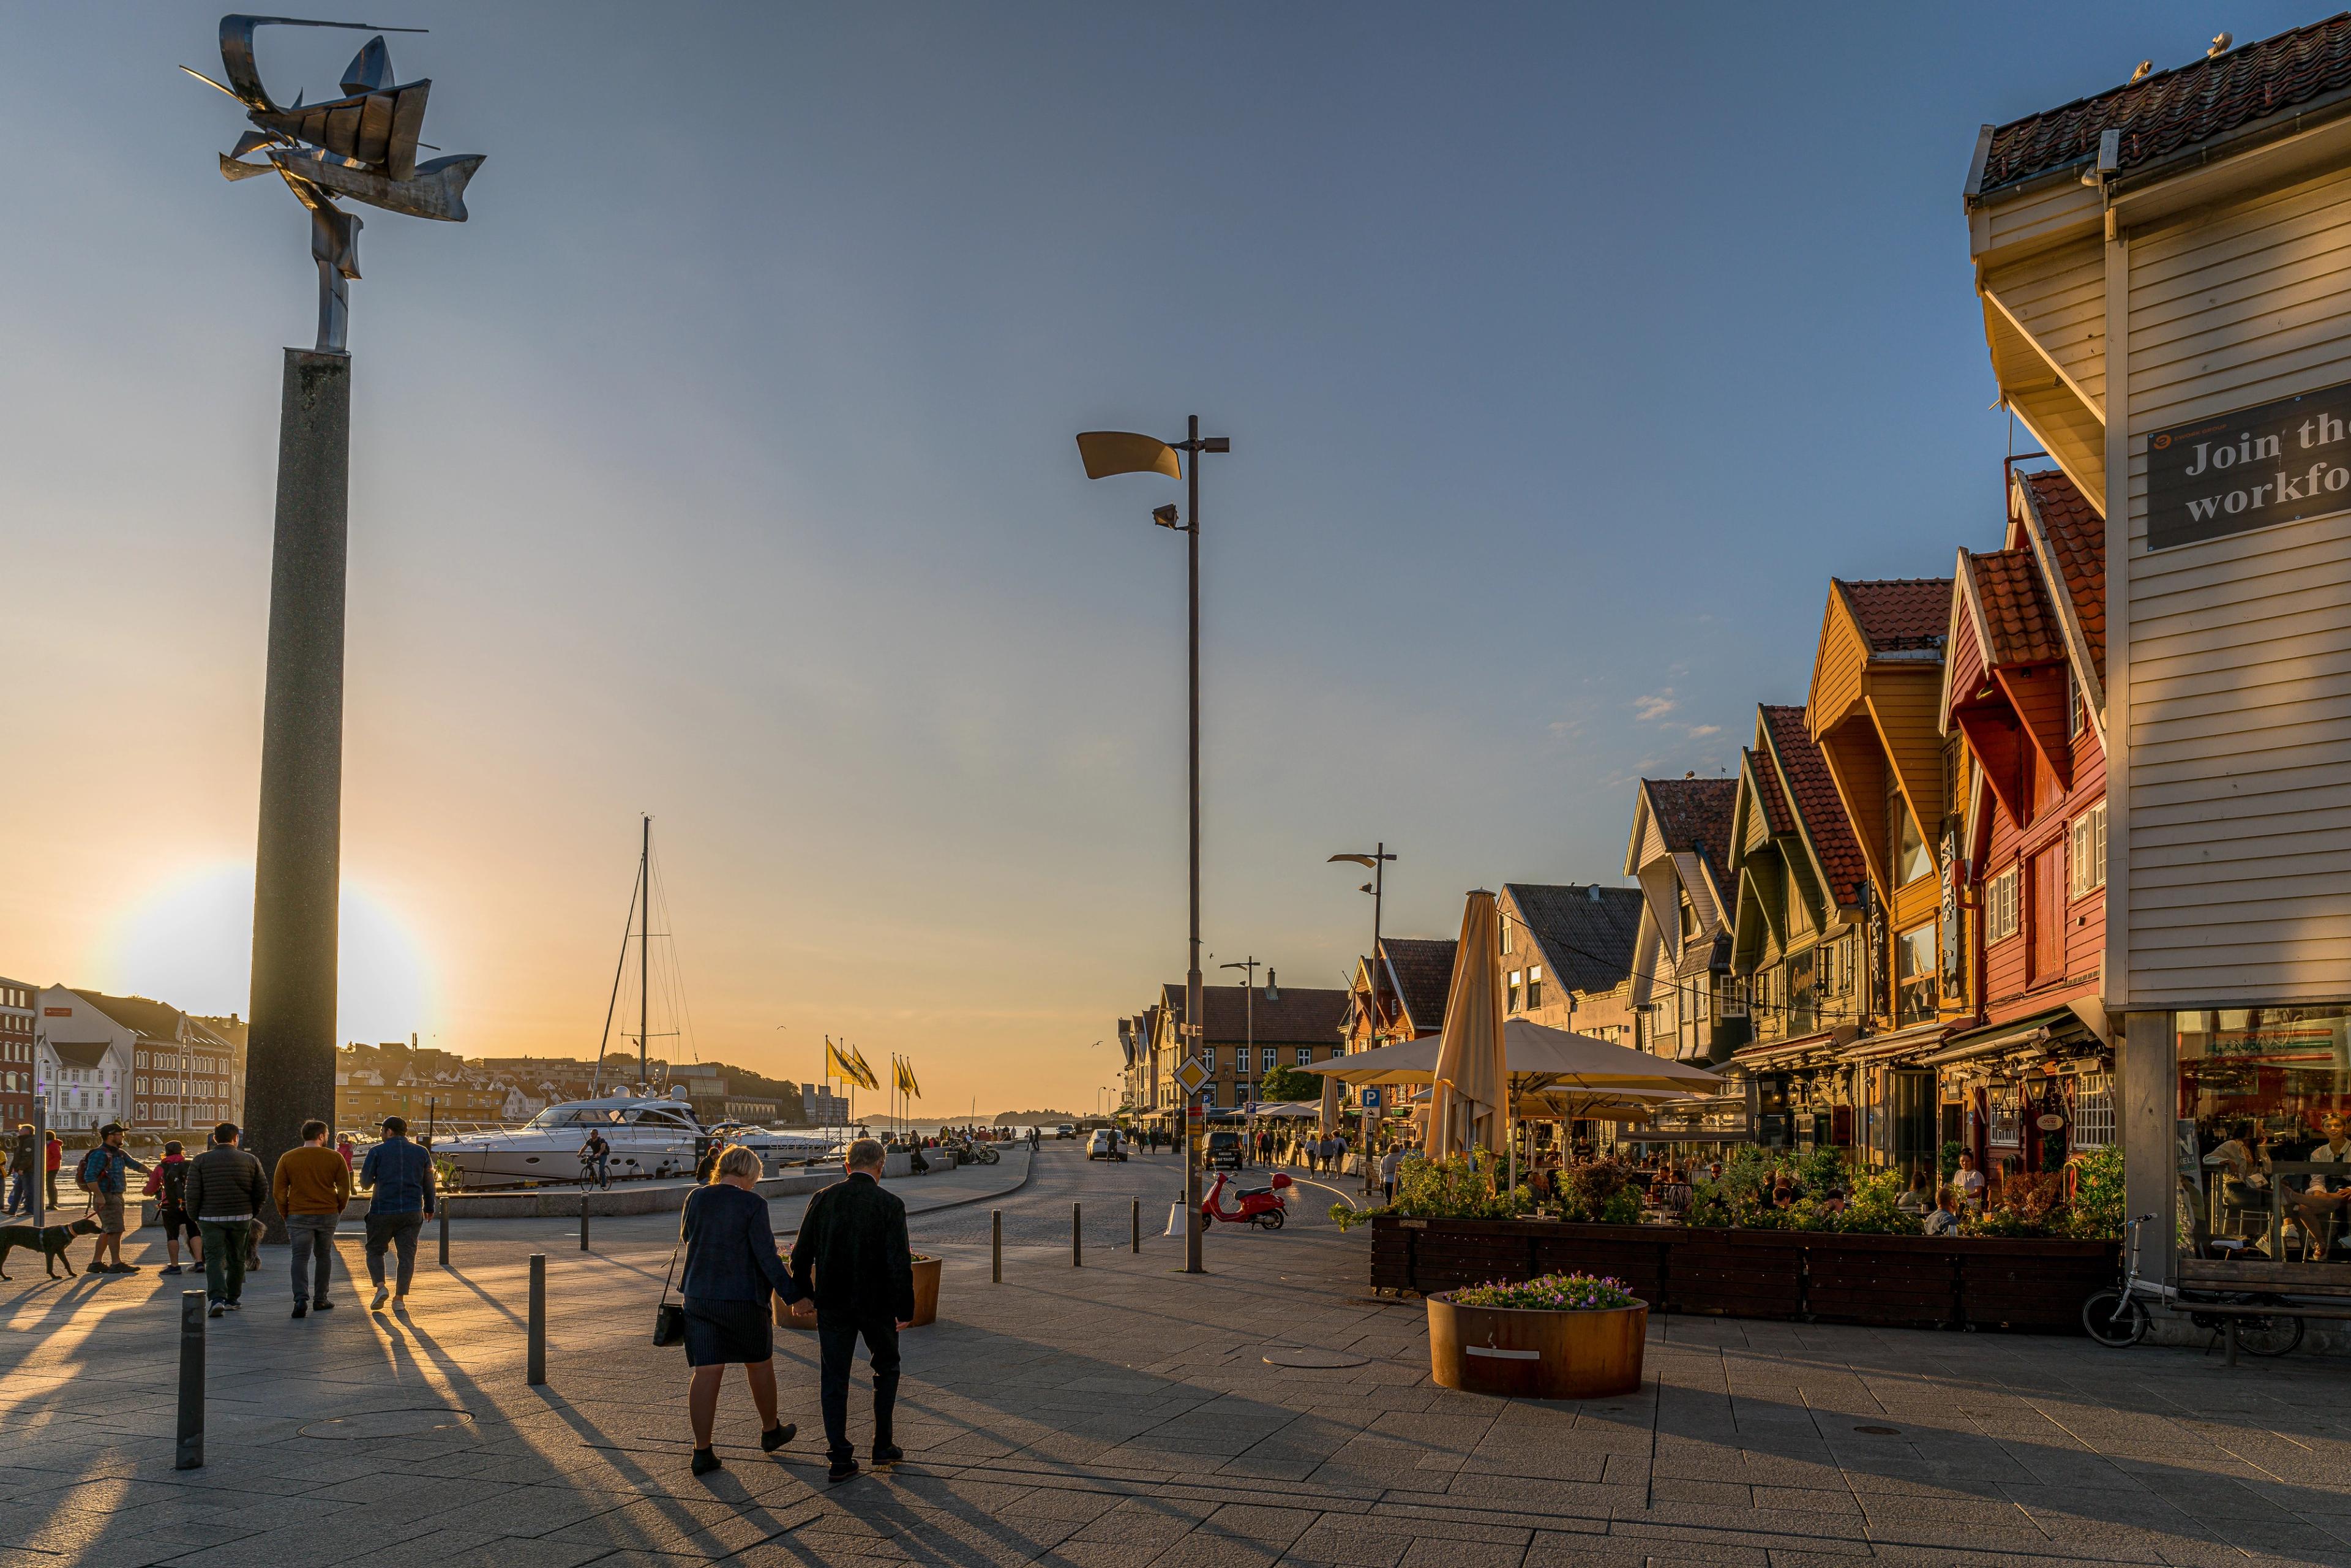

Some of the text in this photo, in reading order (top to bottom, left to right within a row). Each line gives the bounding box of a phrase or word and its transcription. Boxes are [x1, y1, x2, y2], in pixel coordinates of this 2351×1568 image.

[2174, 424, 2227, 441] EWORK GROUP
[2185, 412, 2351, 476] Join th
[2185, 462, 2350, 522] workfo
[1367, 1091, 1376, 1105] P
[1248, 1103, 1254, 1112] P
